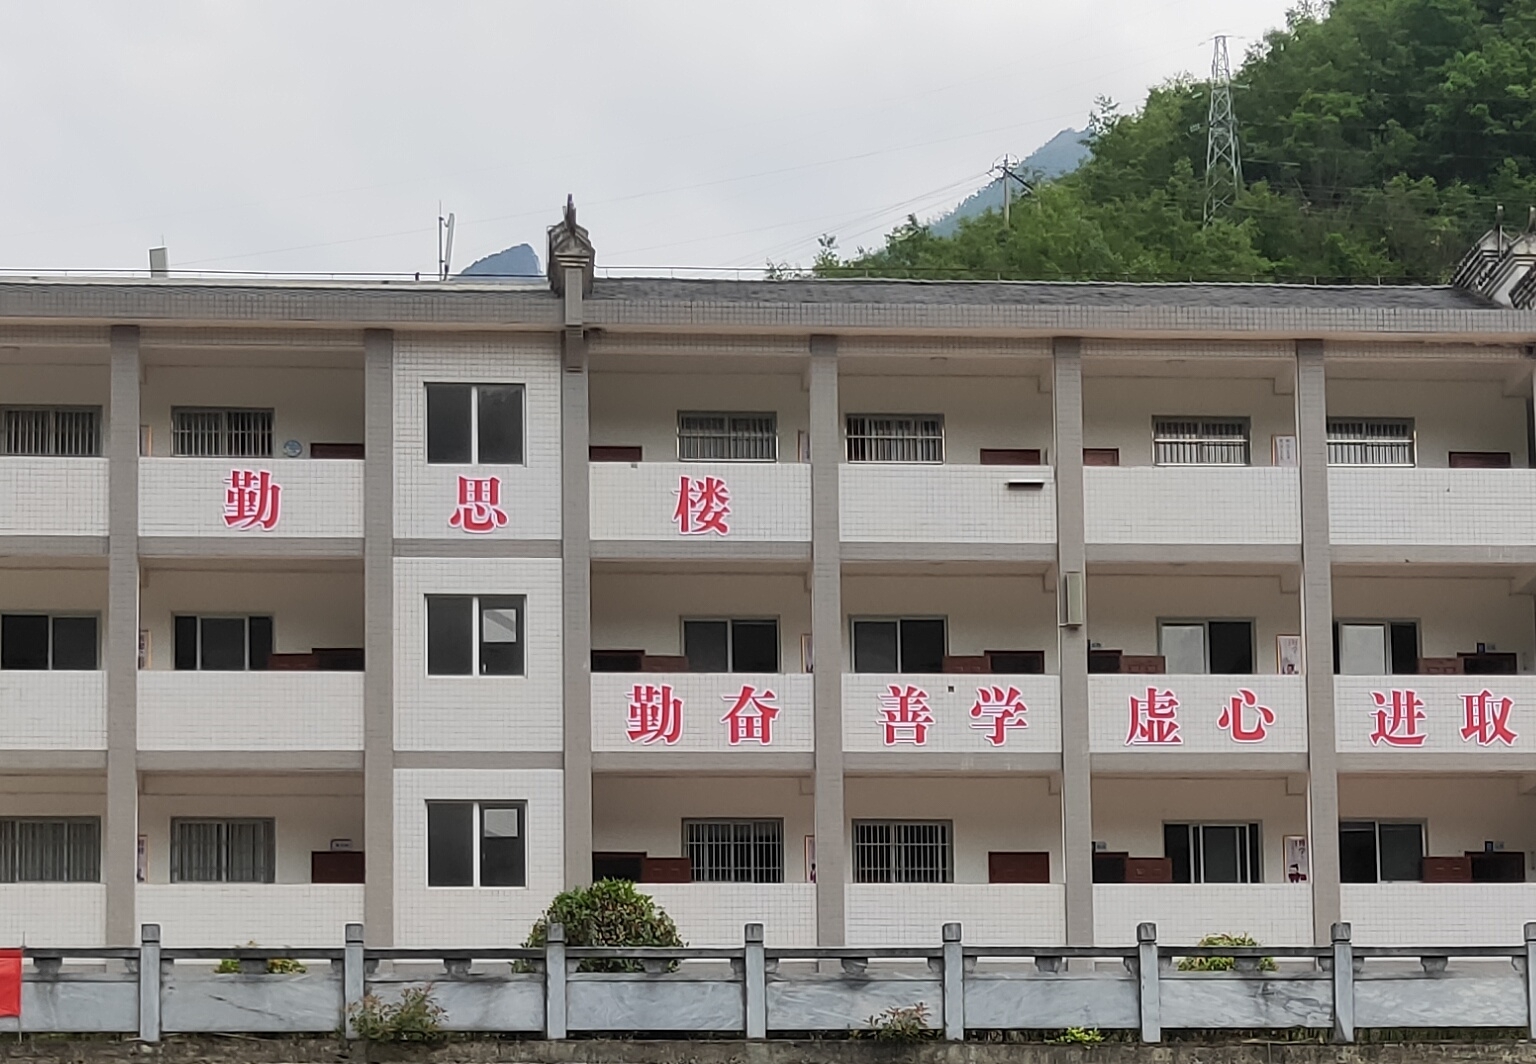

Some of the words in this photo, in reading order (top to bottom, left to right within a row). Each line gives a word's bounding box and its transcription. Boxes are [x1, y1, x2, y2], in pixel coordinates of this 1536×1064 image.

[626, 684, 780, 746] 勤奋
[878, 685, 1028, 746] 善学
[1126, 687, 1275, 746] 虚心
[1370, 689, 1517, 747] 进取
